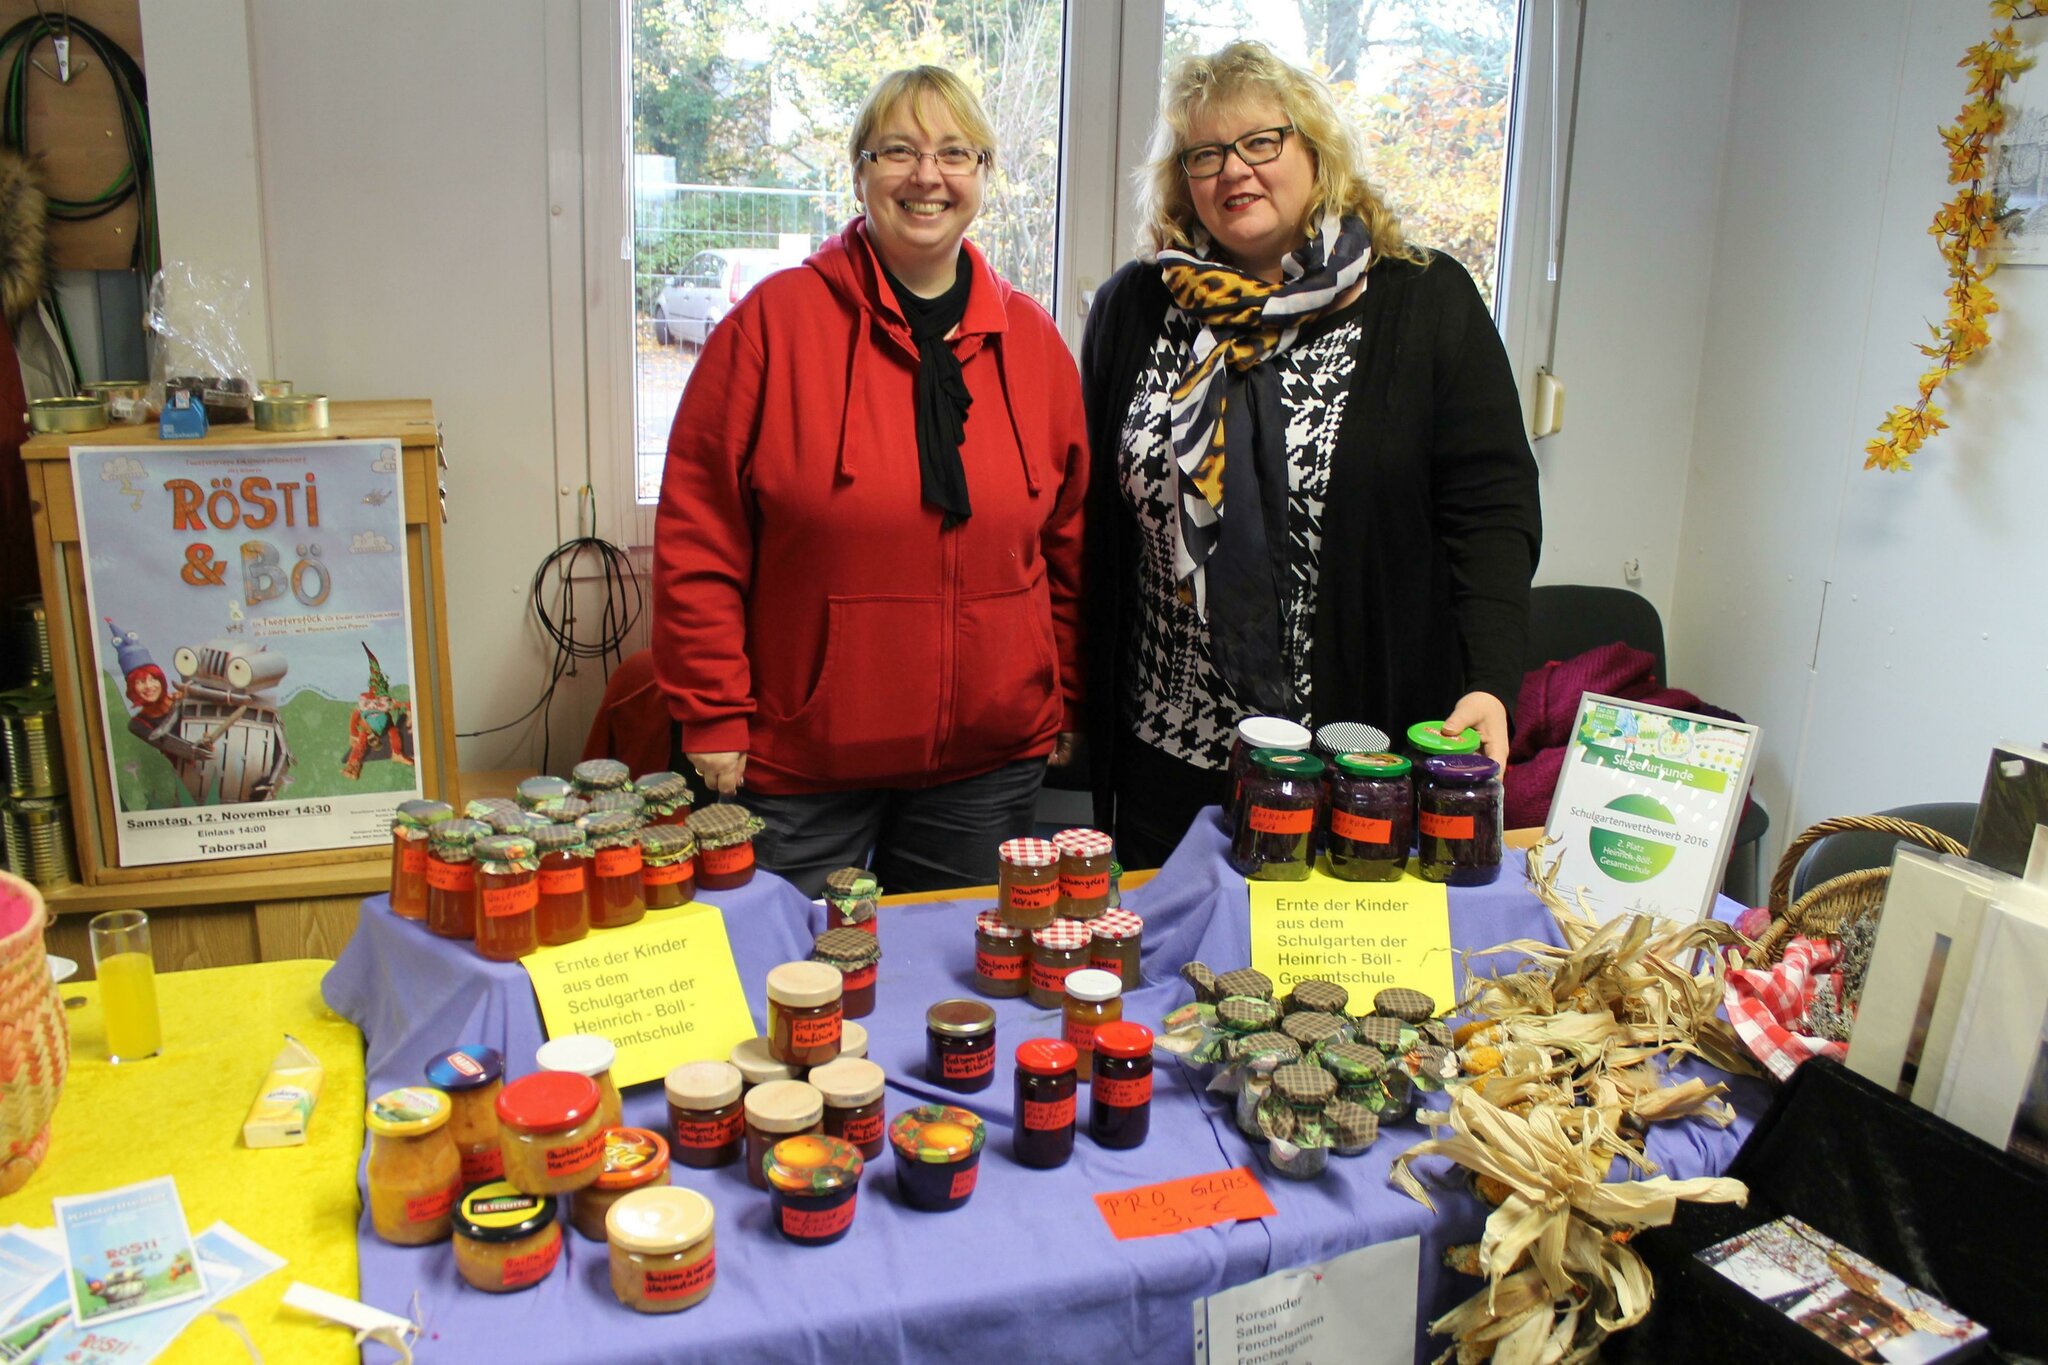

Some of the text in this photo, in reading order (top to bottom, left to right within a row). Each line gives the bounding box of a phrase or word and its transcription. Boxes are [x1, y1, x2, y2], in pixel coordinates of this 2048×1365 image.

[180, 543, 227, 586] &
[1613, 754, 1694, 782] Siegeurkunde
[197, 814, 217, 823] 12.
[222, 805, 290, 821] November
[294, 804, 332, 816] 14:30
[198, 824, 266, 838] Einlass 14:00
[1570, 806, 1709, 848] Schulgartenwettbewerb 2016
[199, 840, 267, 854] Taborsaal
[1626, 841, 1644, 852] Platz
[1600, 857, 1650, 875] Gesamtschule
[1276, 898, 1408, 912] Ernte der Kinder
[1276, 917, 1343, 929] aus dem
[1277, 934, 1407, 950] Schulgarten der
[554, 937, 688, 975] Ernte der Kinder
[1278, 953, 1347, 966] Heinrich
[1362, 953, 1392, 965] Böll
[563, 972, 629, 994] aus dem
[1279, 971, 1395, 985] Gesamtschule
[568, 977, 695, 1015] Schulgarten der
[573, 1009, 643, 1036] Heinrich
[655, 999, 686, 1018] Böll
[608, 1019, 695, 1049] amtschule
[1104, 1176, 1248, 1216] PRO GLAS
[1235, 1296, 1302, 1324] Koreander
[1236, 1320, 1277, 1339] Salbei
[1237, 1315, 1324, 1354] Fenchelsamen
